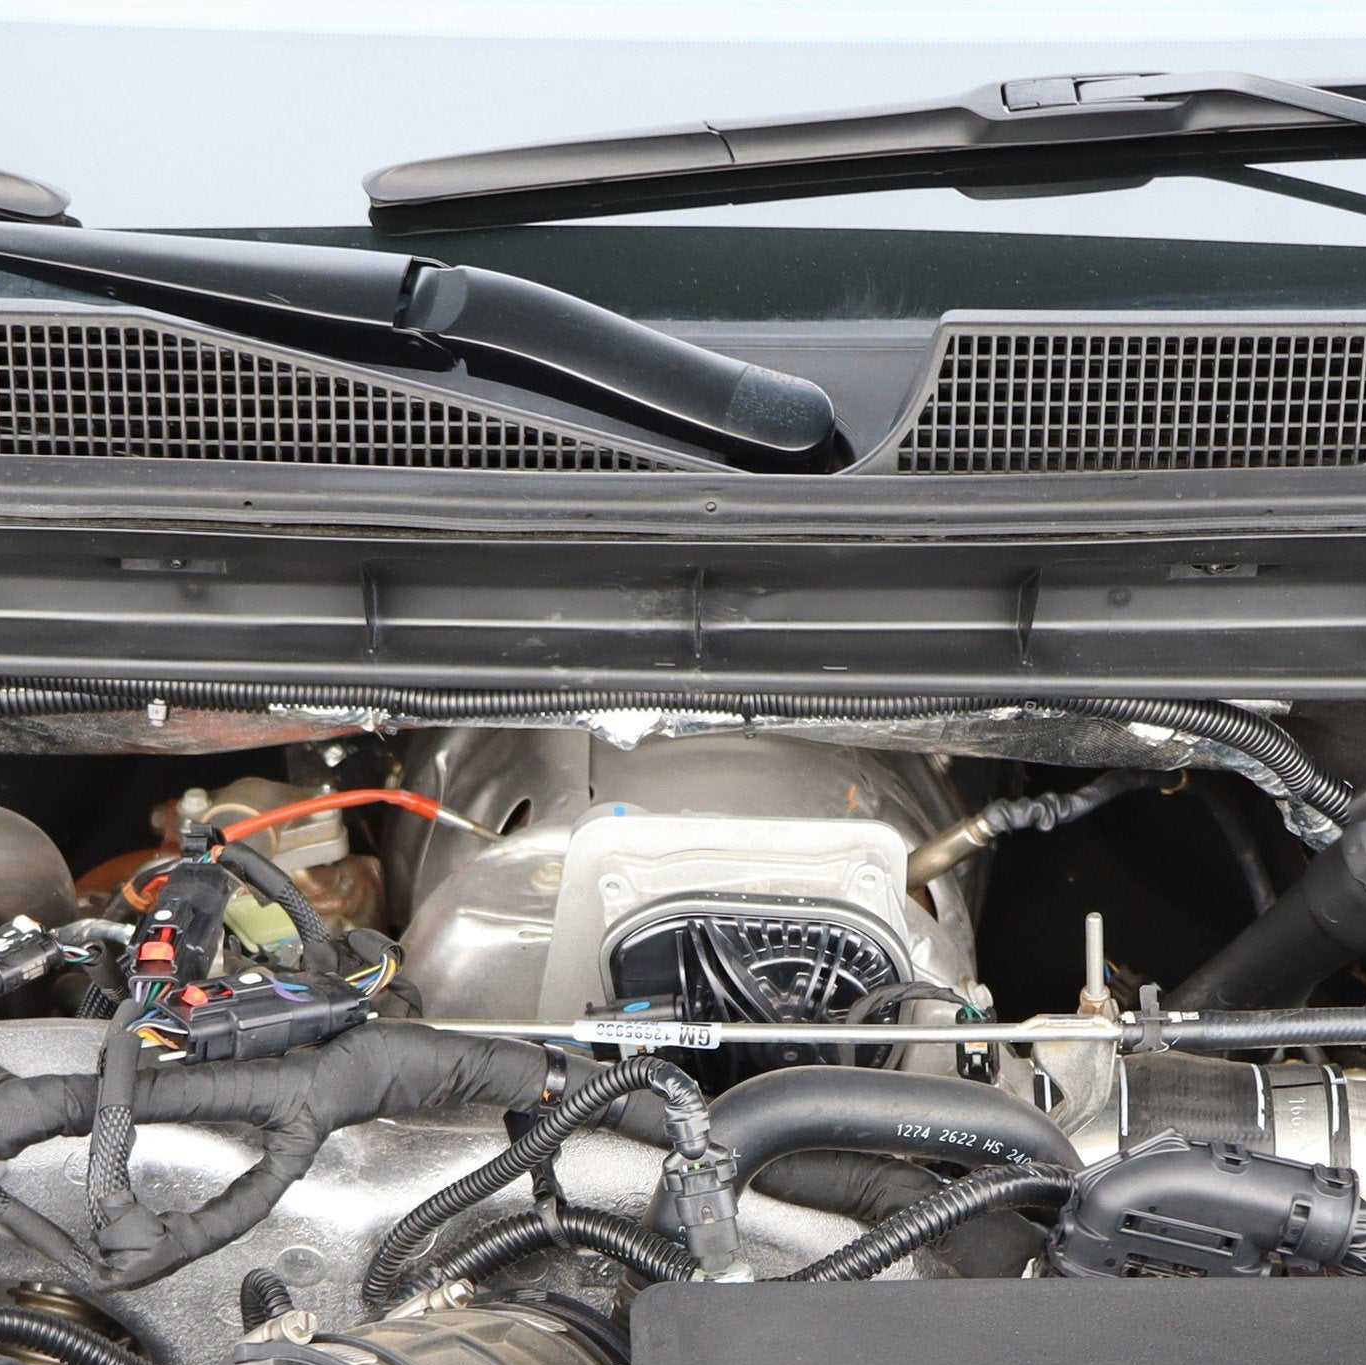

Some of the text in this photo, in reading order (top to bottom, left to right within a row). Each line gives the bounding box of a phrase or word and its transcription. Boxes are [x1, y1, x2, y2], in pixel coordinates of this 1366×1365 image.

[679, 1026, 711, 1046] GM
[896, 1123, 931, 1140] 1274
[939, 1129, 978, 1147] 2622
[982, 1139, 1005, 1155] HS
